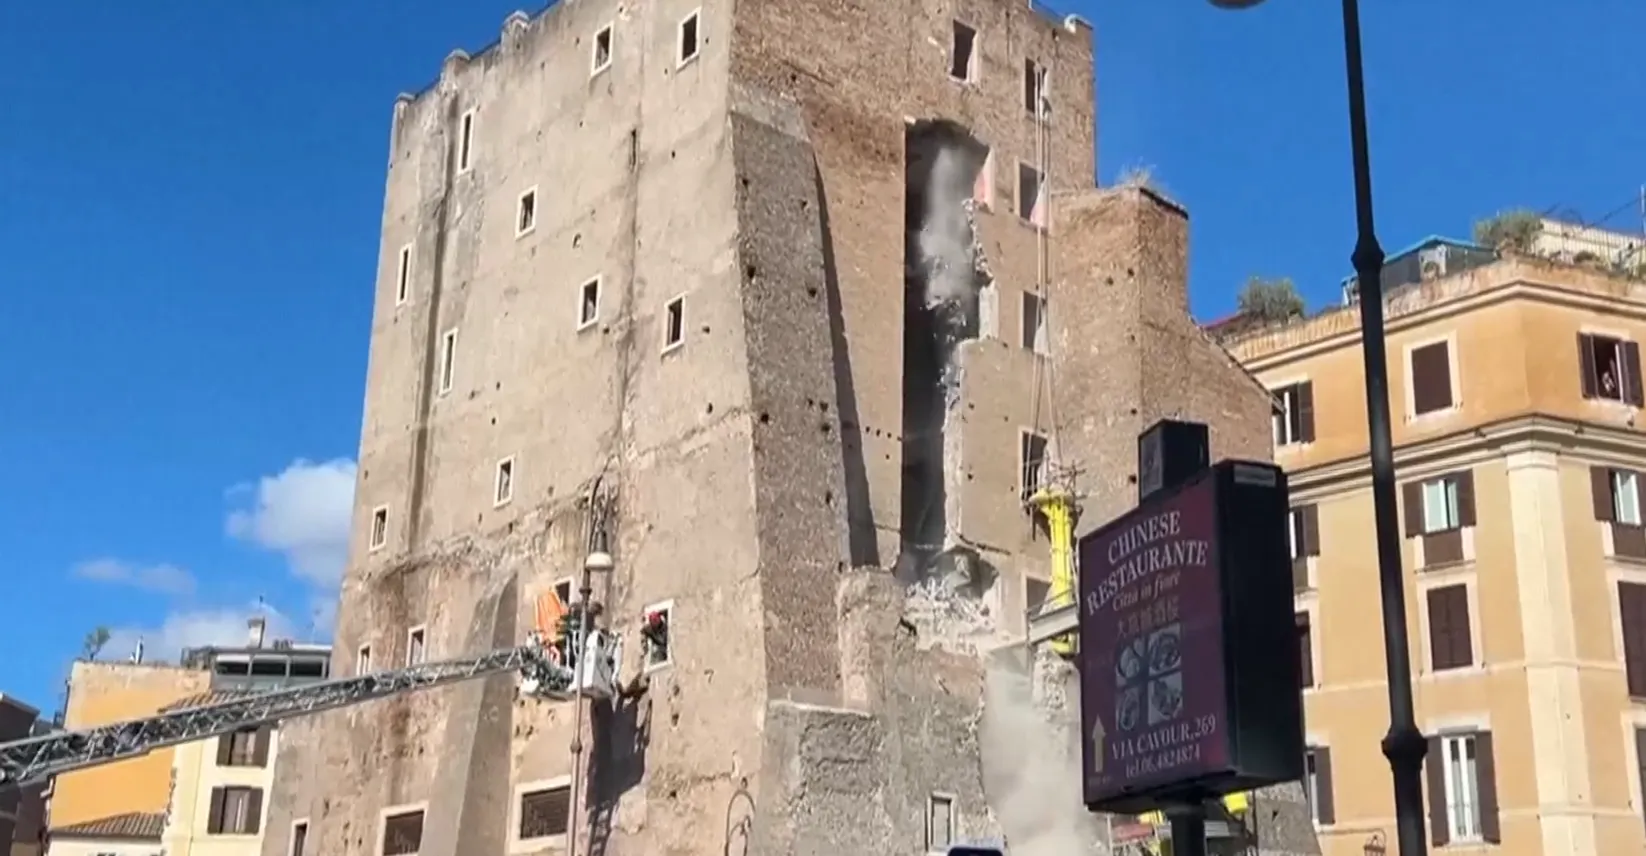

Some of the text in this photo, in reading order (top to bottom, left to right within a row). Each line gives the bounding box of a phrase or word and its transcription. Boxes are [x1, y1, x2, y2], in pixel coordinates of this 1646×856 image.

[1108, 511, 1180, 564] CHINESE
[1086, 540, 1208, 615] RESTAURANTE
[1112, 738, 1134, 760] VIA
